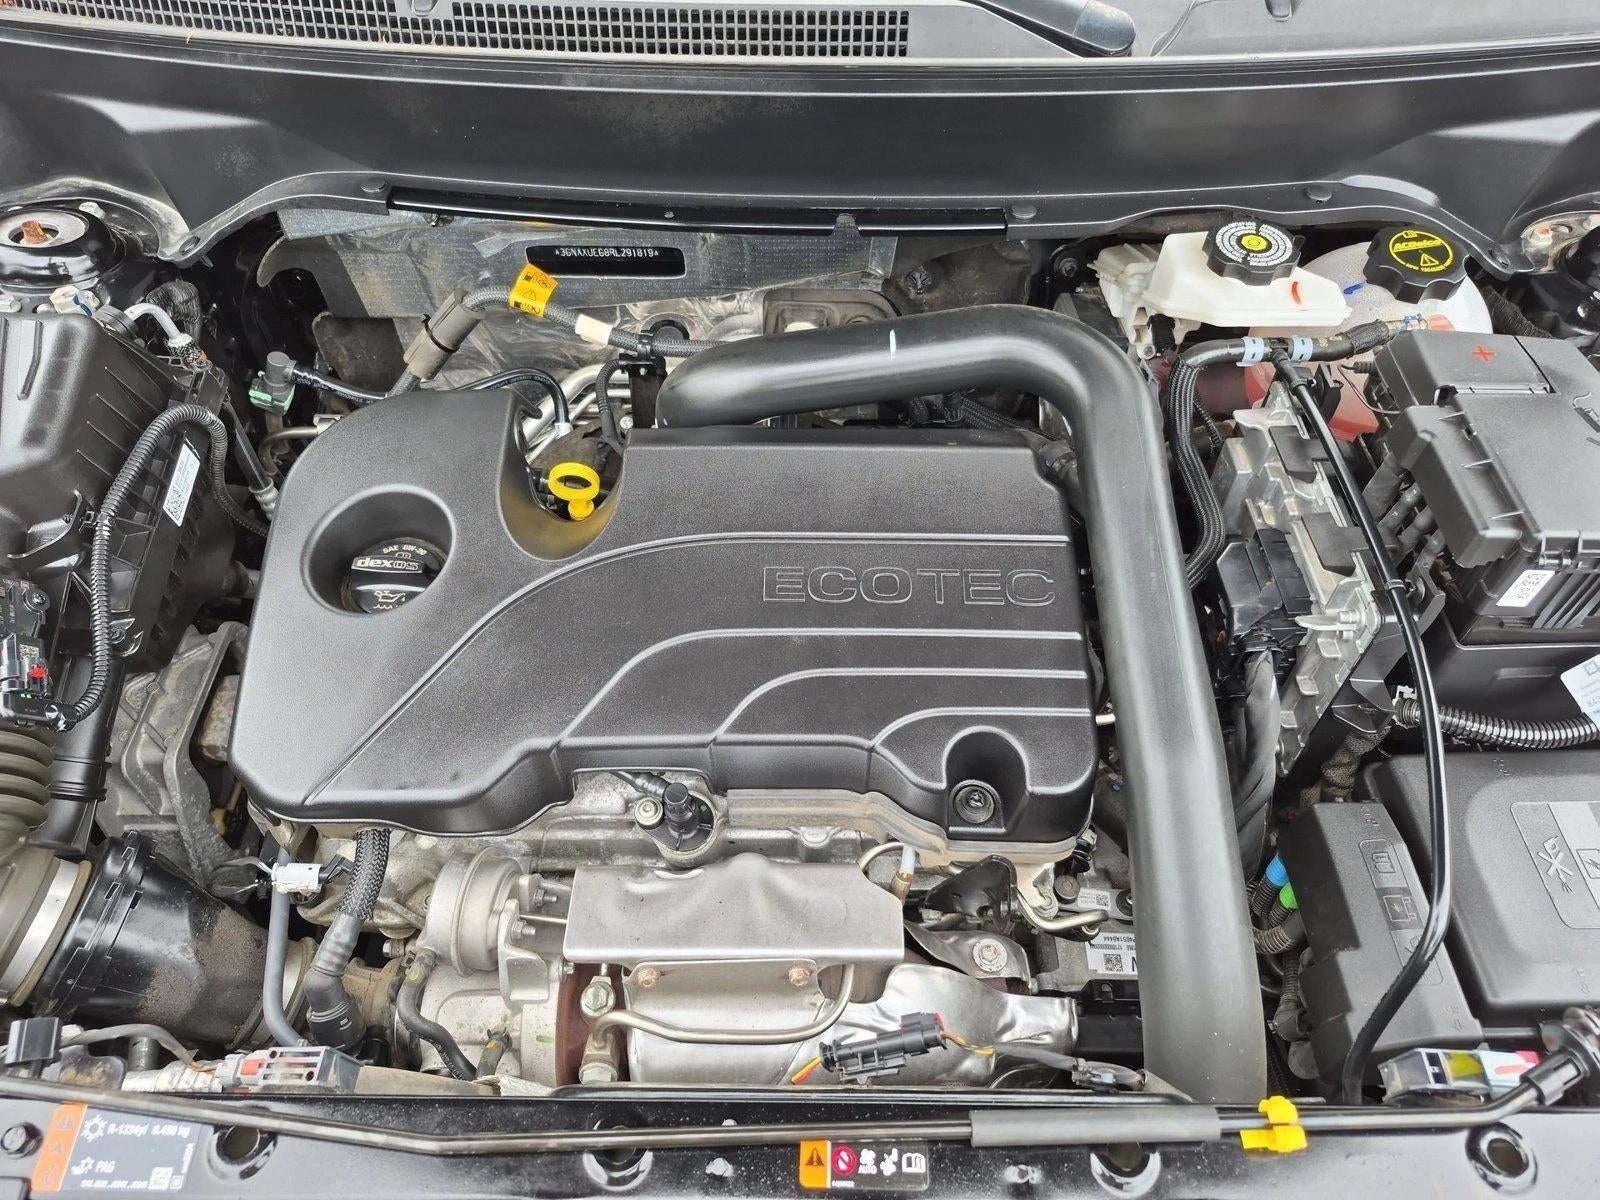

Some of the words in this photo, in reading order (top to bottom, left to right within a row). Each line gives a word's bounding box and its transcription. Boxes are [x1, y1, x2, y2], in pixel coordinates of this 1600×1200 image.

[382, 544, 399, 554] SAE
[356, 557, 420, 571] dexos
[763, 566, 1056, 607] ECOTEC
[95, 1160, 116, 1173] PAG
[858, 1164, 878, 1174] AUTO
